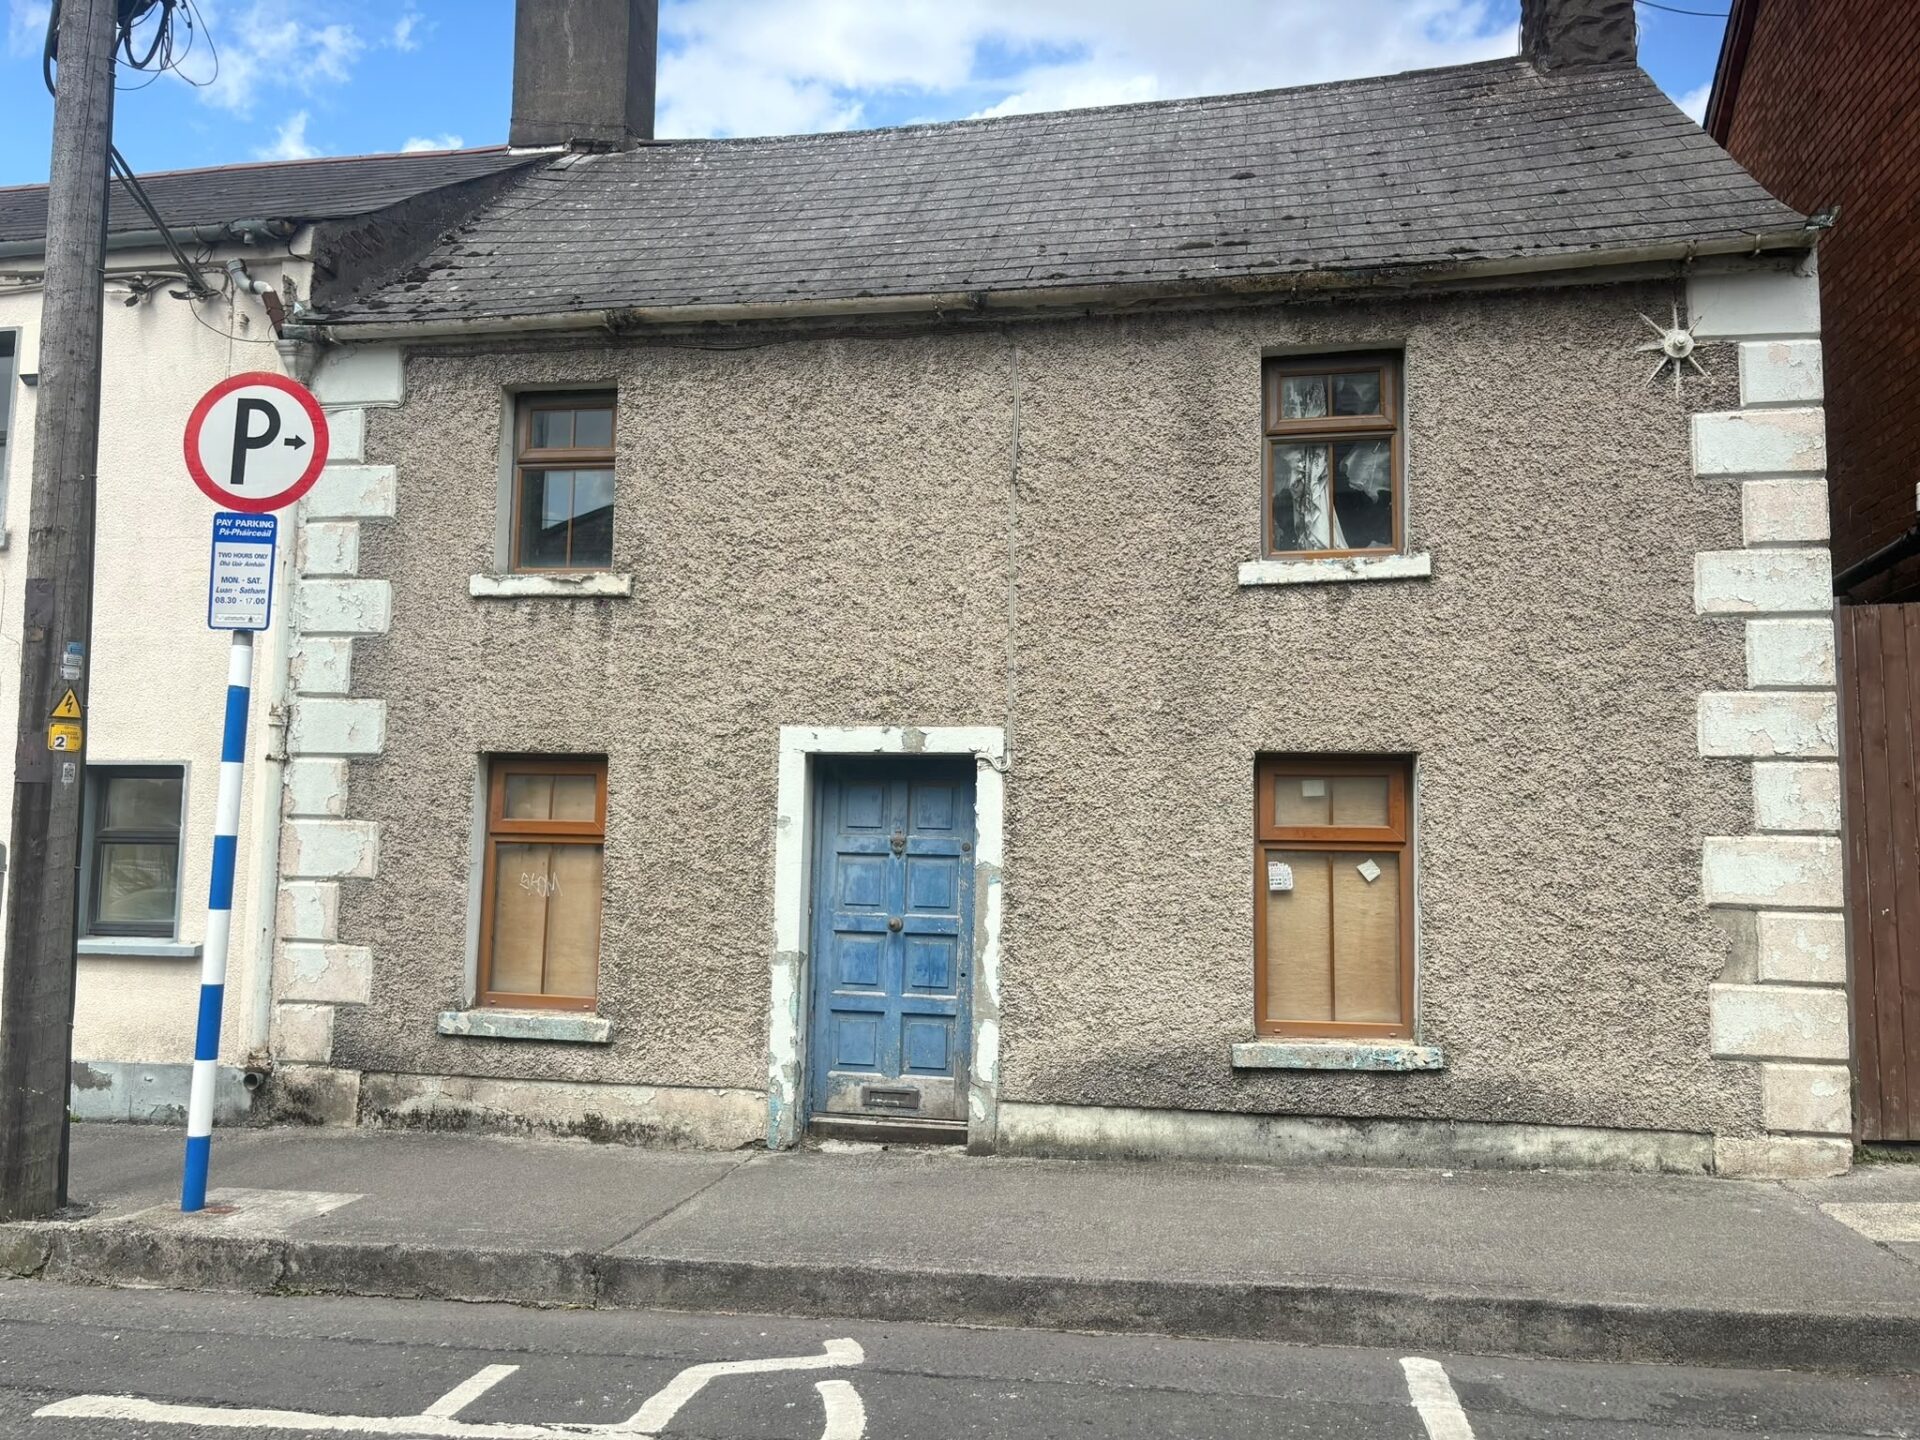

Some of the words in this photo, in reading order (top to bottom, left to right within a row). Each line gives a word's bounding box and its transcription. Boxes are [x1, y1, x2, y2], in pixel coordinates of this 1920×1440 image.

[230, 398, 281, 485] P
[216, 518, 233, 527] PAY
[235, 519, 275, 528] PARKING
[215, 596, 237, 604] 08.30
[245, 597, 266, 605] 17.00
[55, 736, 65, 748] 2
